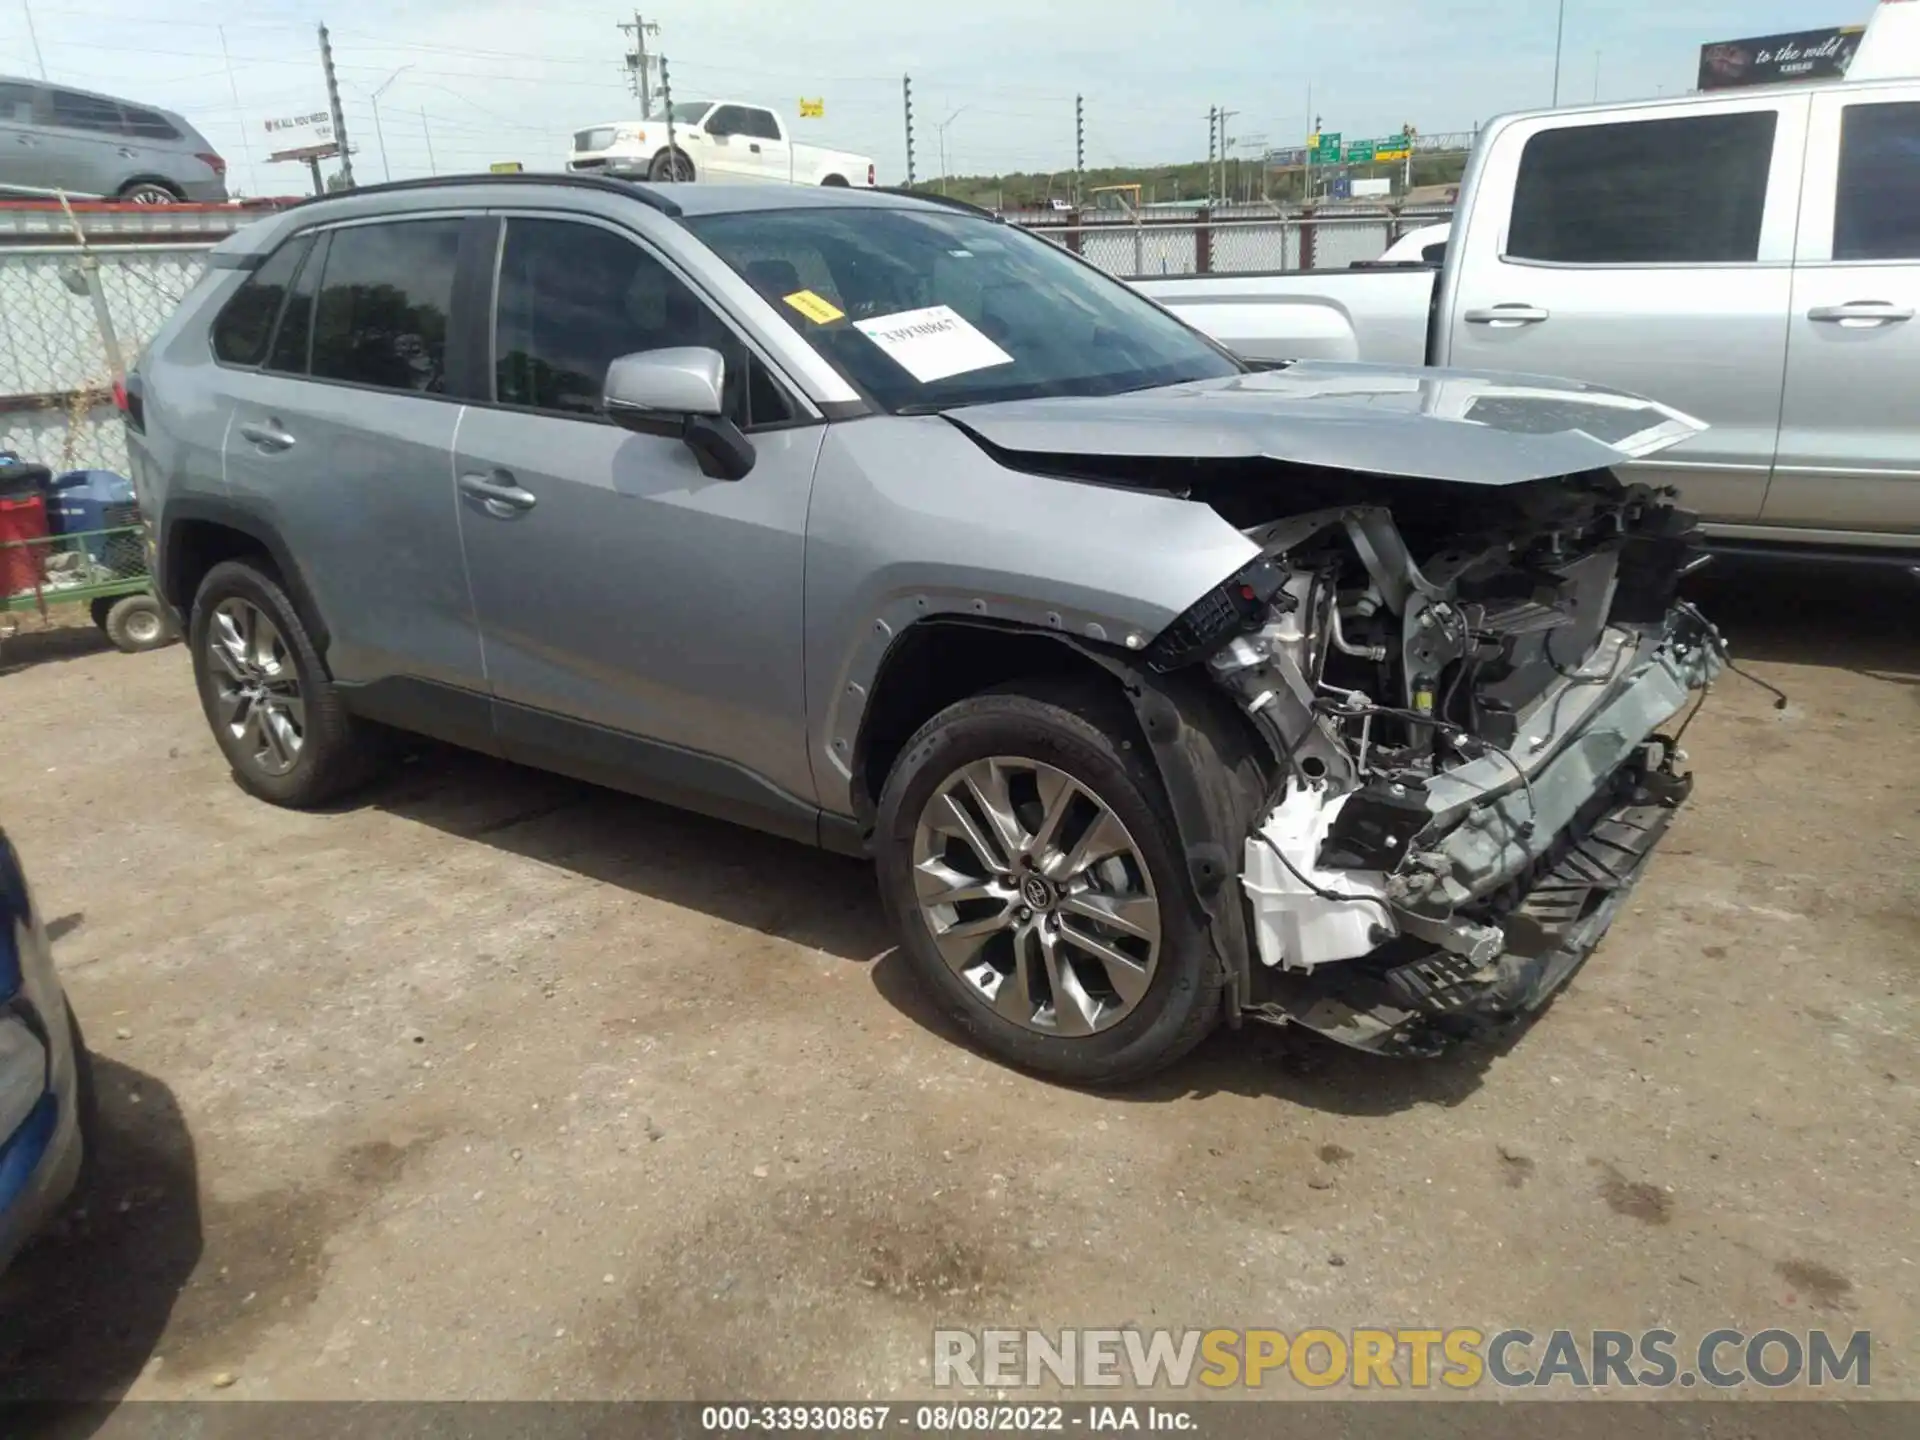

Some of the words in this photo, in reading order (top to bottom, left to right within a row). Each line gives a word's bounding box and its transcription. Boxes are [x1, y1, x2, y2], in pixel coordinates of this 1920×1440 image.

[1755, 48, 1771, 64] to
[1775, 41, 1801, 62] the
[1803, 36, 1844, 59] wild
[282, 118, 294, 128] ALL
[294, 116, 309, 126] YOU
[310, 111, 329, 122] NEED
